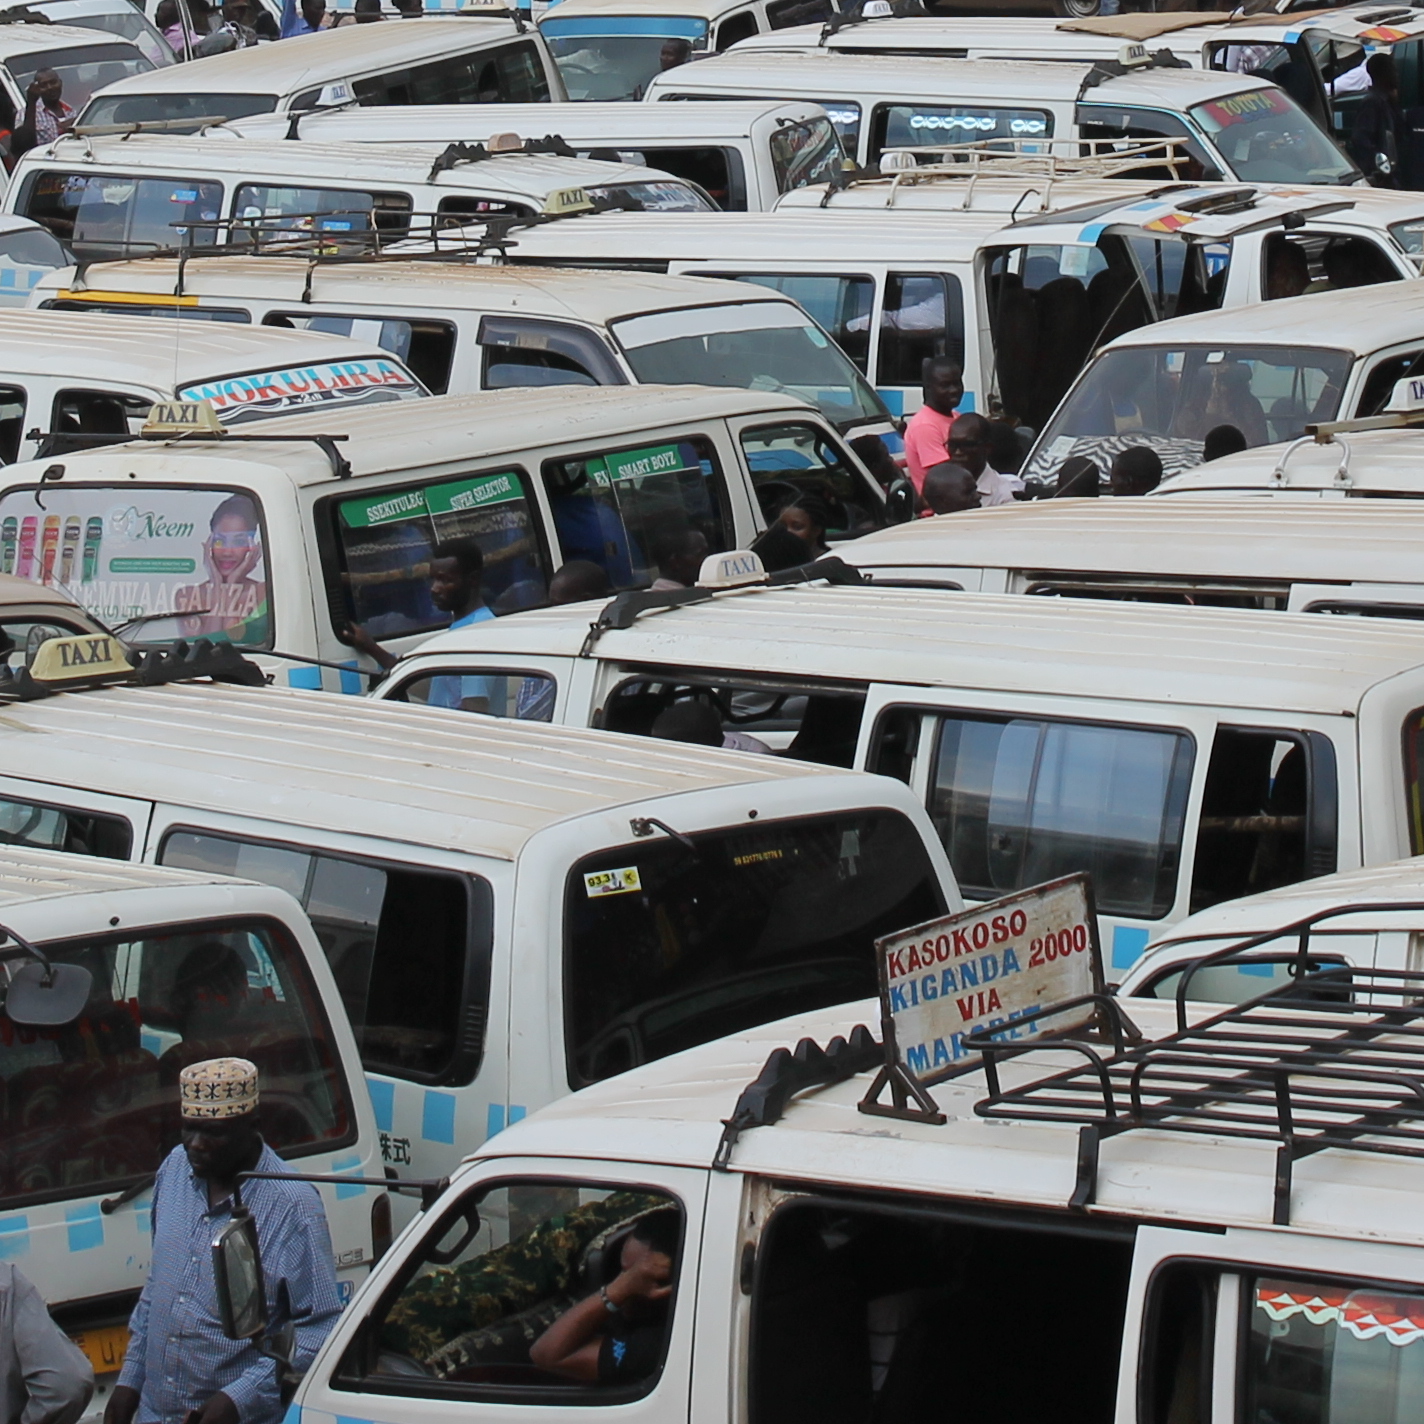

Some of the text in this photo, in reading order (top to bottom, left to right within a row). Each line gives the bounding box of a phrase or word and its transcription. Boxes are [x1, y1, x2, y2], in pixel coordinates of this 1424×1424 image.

[1217, 91, 1276, 117] TOYOTA
[559, 189, 584, 206] TAXI
[183, 361, 408, 409] WOKULIRA
[156, 404, 199, 424] TAXI
[618, 451, 677, 480] SMART BOYZ
[137, 515, 195, 539] Neem
[721, 555, 757, 578] TAXI
[56, 638, 112, 667] TAXI
[887, 909, 1087, 980] KASOKOSO 2000
[888, 947, 1021, 1014] KIGANDA
[956, 987, 1002, 1022] VIA
